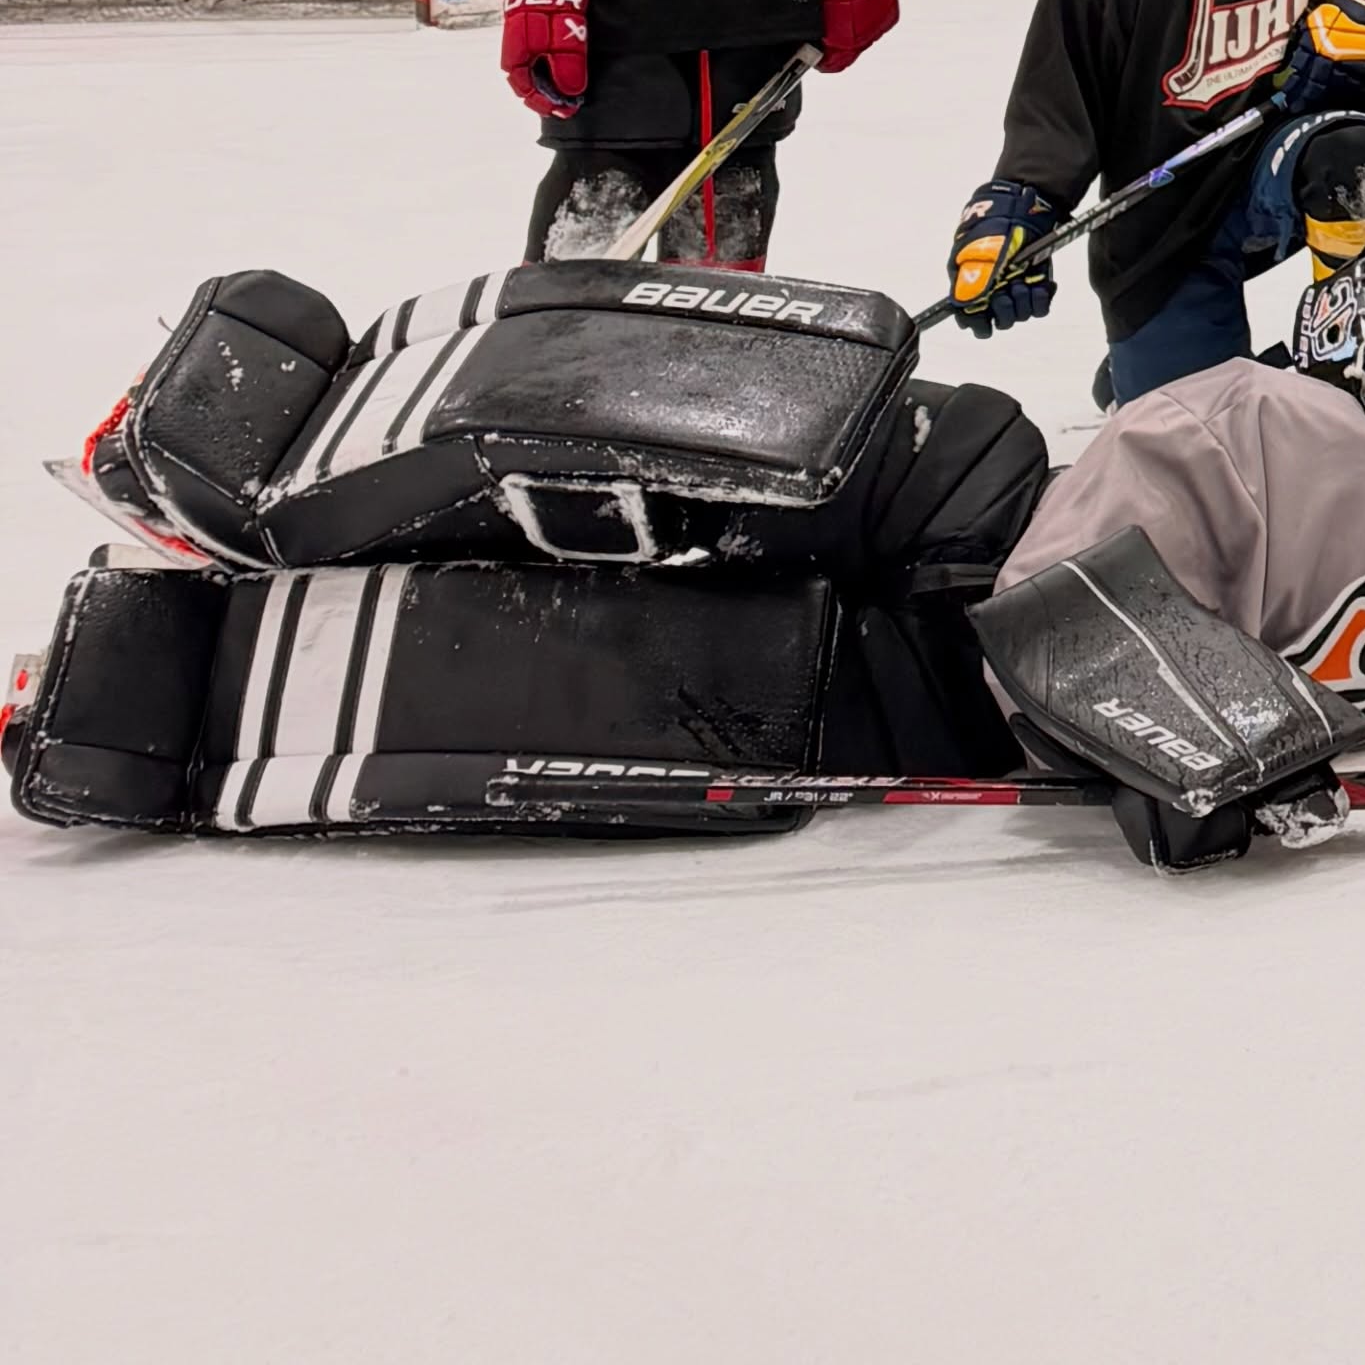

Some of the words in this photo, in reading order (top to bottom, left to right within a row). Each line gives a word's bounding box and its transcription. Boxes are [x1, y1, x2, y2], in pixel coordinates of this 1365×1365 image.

[623, 281, 824, 327] BAUER
[1093, 699, 1222, 771] BAUER
[764, 792, 783, 802] JR
